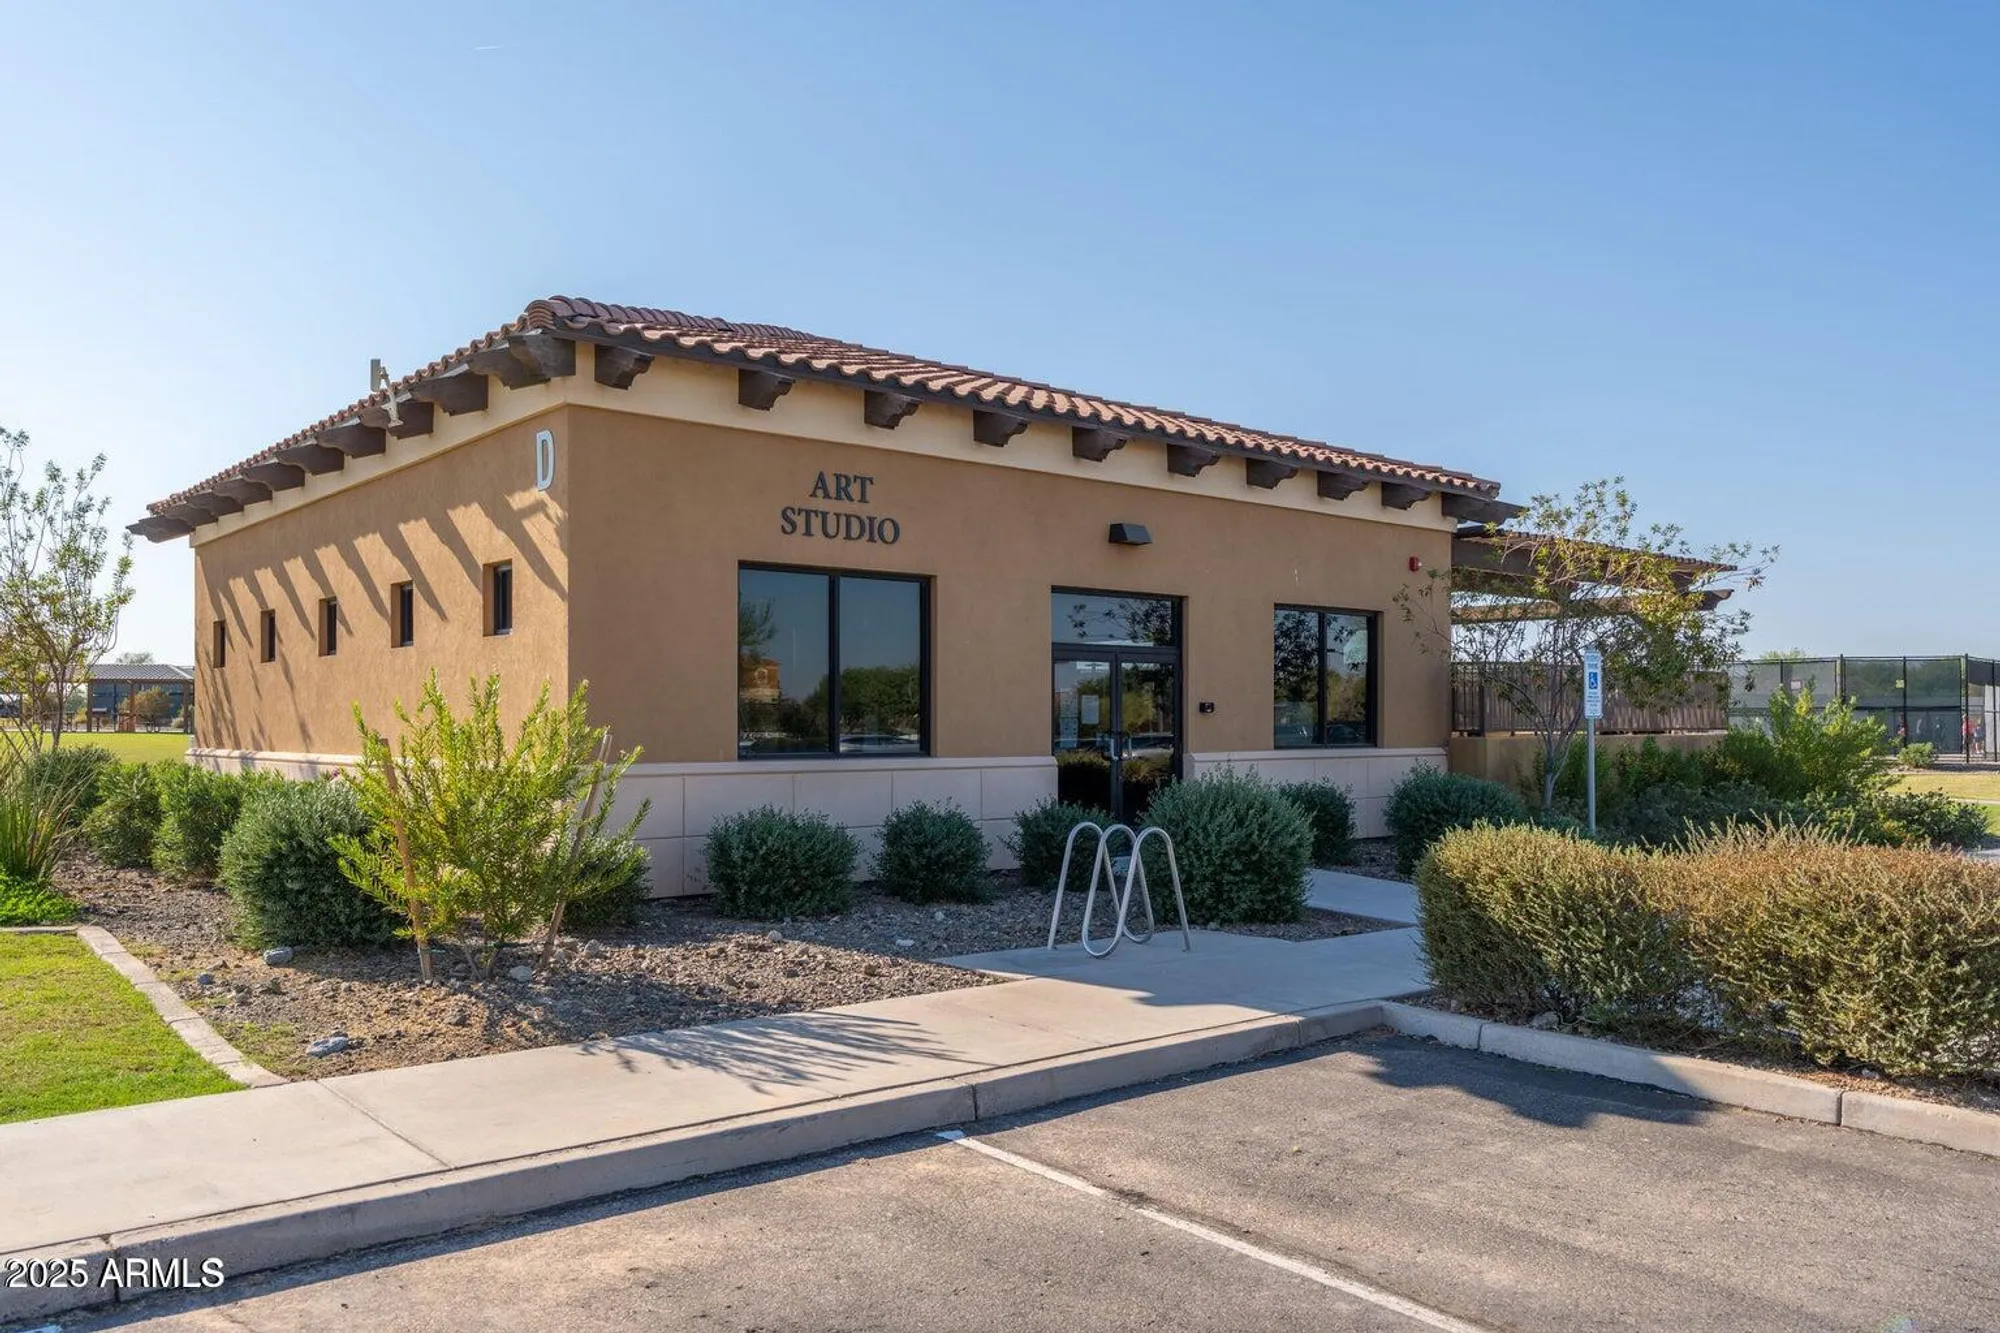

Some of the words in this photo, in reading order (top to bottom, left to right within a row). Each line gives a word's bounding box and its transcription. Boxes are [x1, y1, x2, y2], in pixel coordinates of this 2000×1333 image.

[536, 429, 555, 492] D
[809, 471, 874, 503] ART
[781, 506, 900, 545] STUDIO
